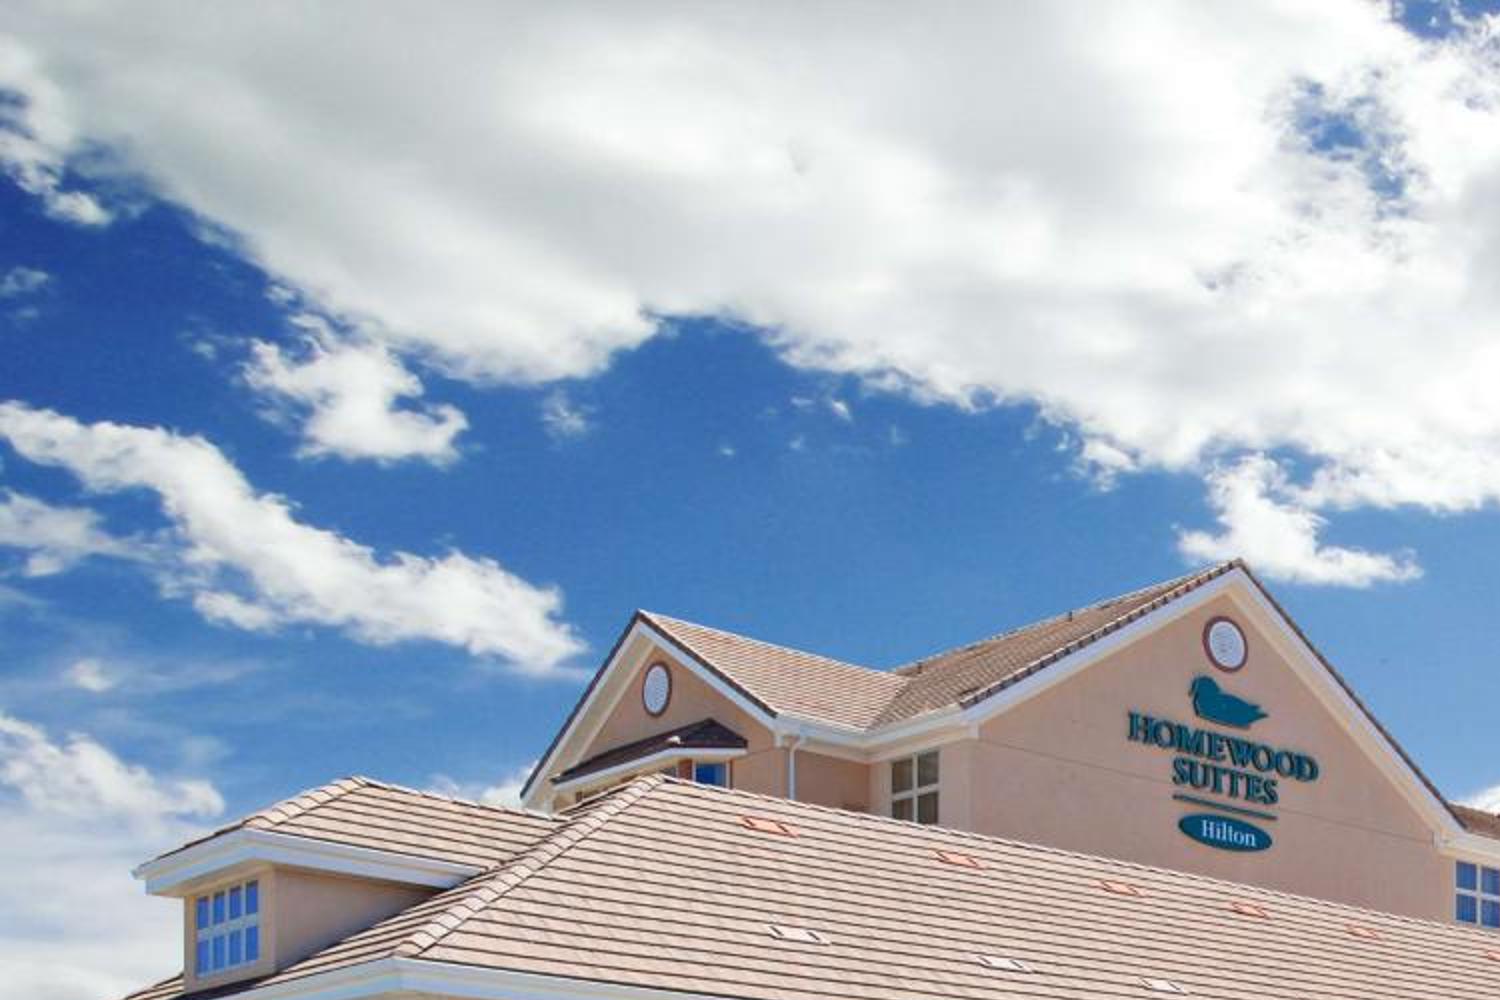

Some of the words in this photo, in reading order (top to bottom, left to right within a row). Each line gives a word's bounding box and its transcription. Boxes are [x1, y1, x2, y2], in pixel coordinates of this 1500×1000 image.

[1127, 711, 1320, 783] HOMEWOOD
[1172, 756, 1279, 805] SUITES
[1200, 819, 1257, 848] Hilton
